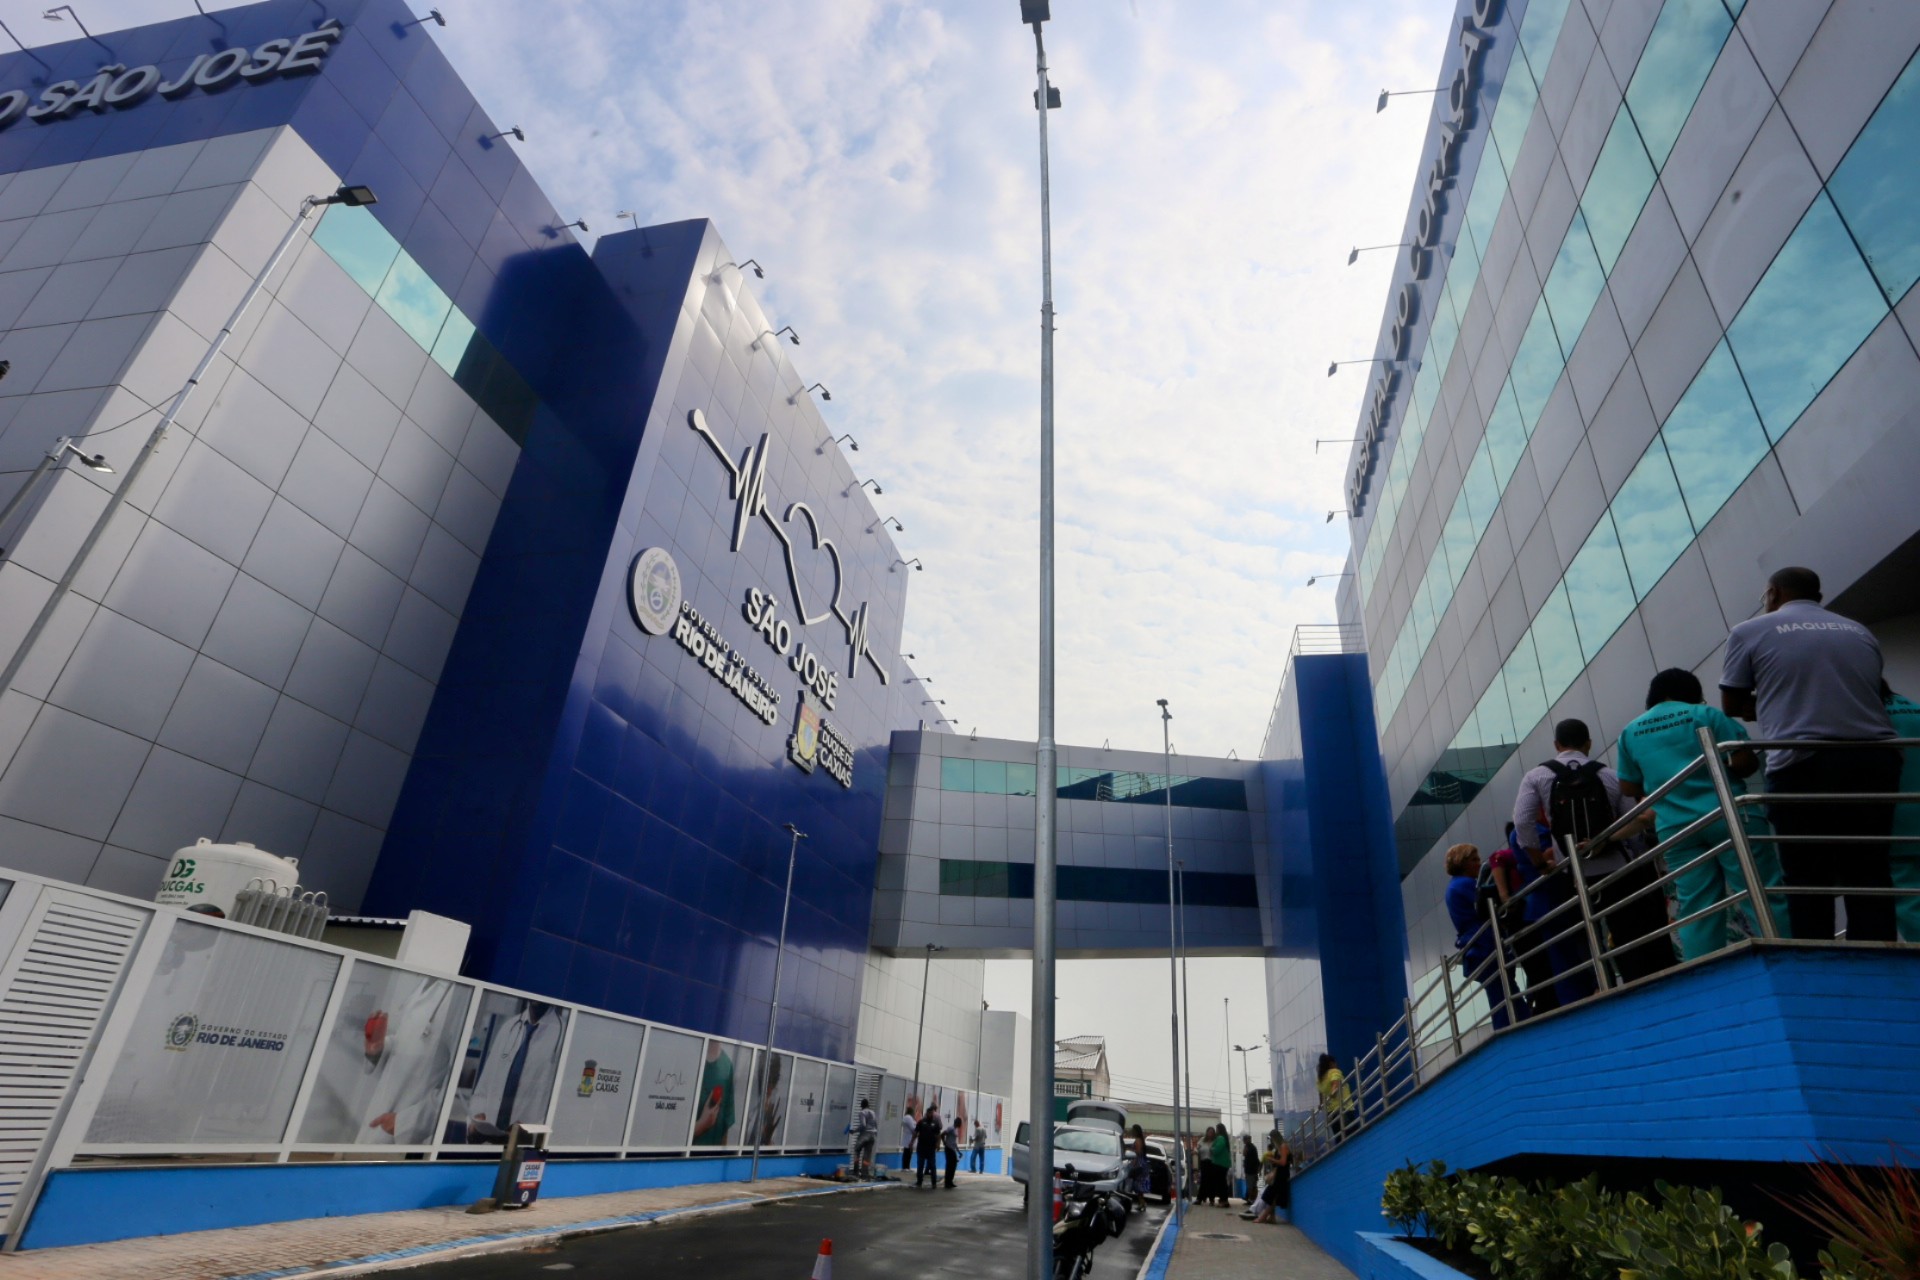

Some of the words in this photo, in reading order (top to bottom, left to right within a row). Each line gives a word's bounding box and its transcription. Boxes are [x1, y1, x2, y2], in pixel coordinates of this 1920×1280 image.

[26, 63, 162, 122] SÃO
[157, 18, 344, 98] JOSÉ
[1349, 360, 1394, 518] HOSPITAL
[1392, 283, 1416, 361] DO
[1775, 621, 1865, 635] MAQUEIRO
[682, 600, 730, 653] GOVERNO
[732, 650, 746, 669] DO
[748, 666, 781, 704] ESTADO
[744, 586, 792, 655] SÃO
[790, 642, 839, 712] JOSÉ
[675, 615, 706, 657] RIO
[704, 642, 727, 679] DE
[724, 664, 778, 726] JANEIRO
[1633, 717, 1694, 737] ENFERMAGEM
[820, 747, 853, 789] CAXIAS
[822, 729, 846, 763] DUQUE
[844, 752, 854, 770] DE
[196, 1032, 219, 1046] RIO
[219, 1035, 237, 1047] DE
[237, 1036, 285, 1052] JANEIRO
[200, 1024, 241, 1035] GOVERNO
[244, 1029, 255, 1037] DO
[258, 1031, 288, 1041] ESTADO
[595, 1082, 619, 1094] CAXIAS
